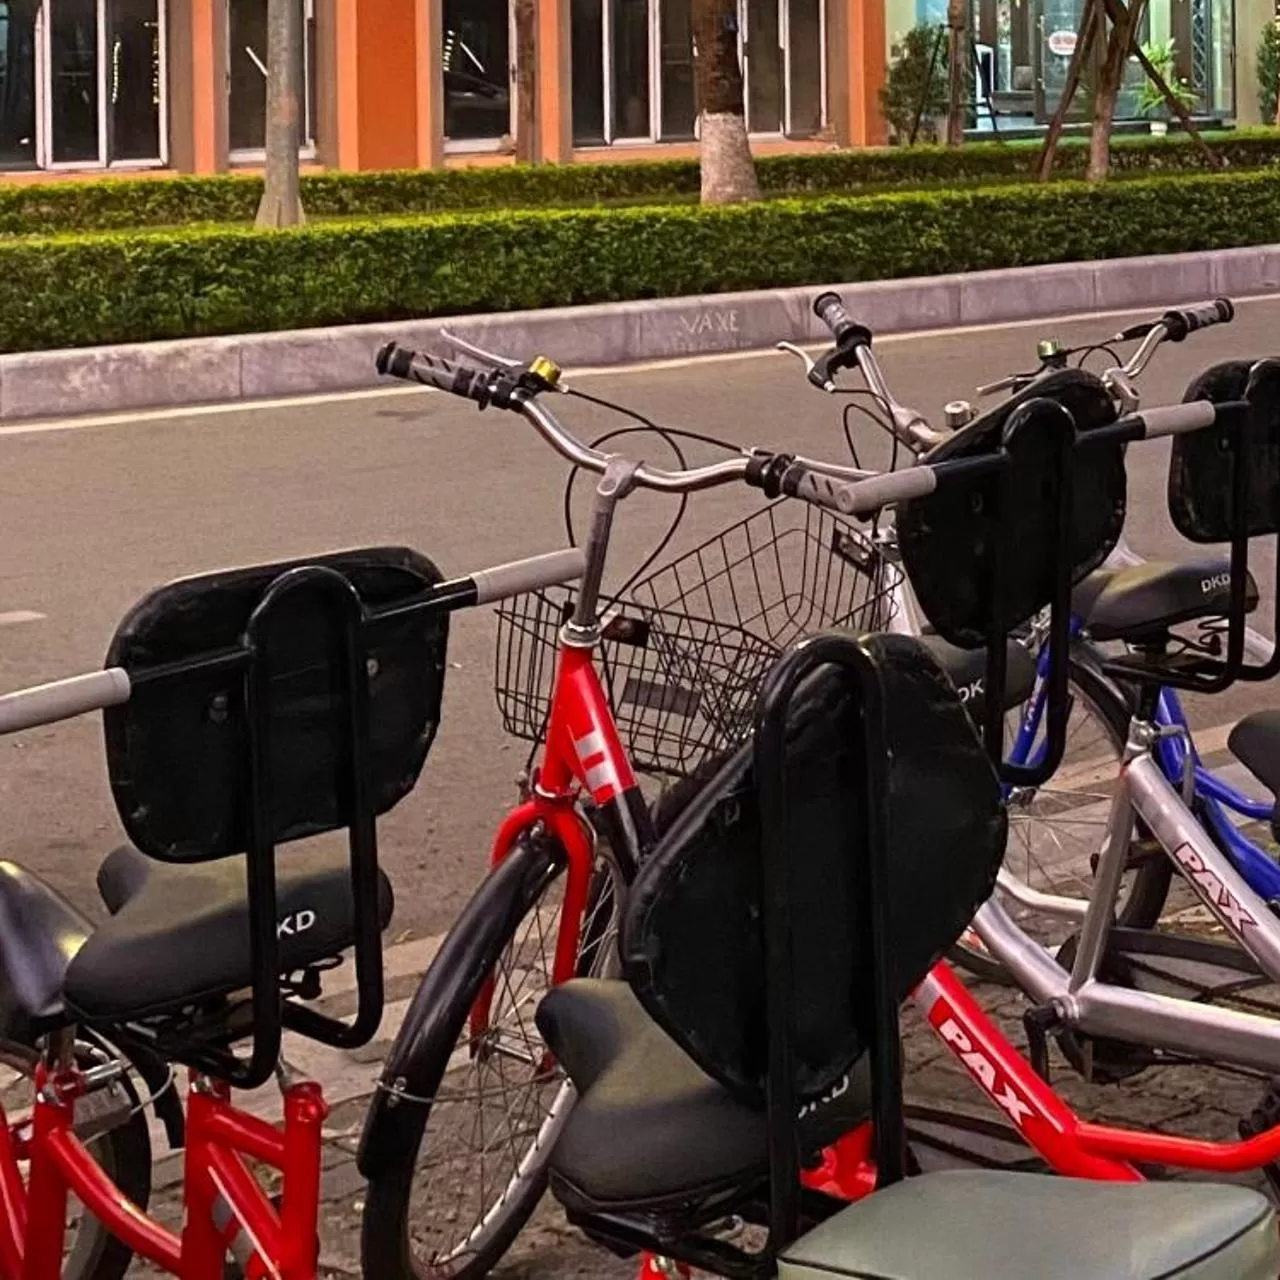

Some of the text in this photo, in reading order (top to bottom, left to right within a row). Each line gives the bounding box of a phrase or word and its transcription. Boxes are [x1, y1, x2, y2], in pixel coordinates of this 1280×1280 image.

[1200, 573, 1231, 593] DKD
[957, 678, 985, 703] DK
[1173, 841, 1258, 936] PAX
[275, 910, 316, 940] KD
[939, 1018, 1035, 1127] PAX
